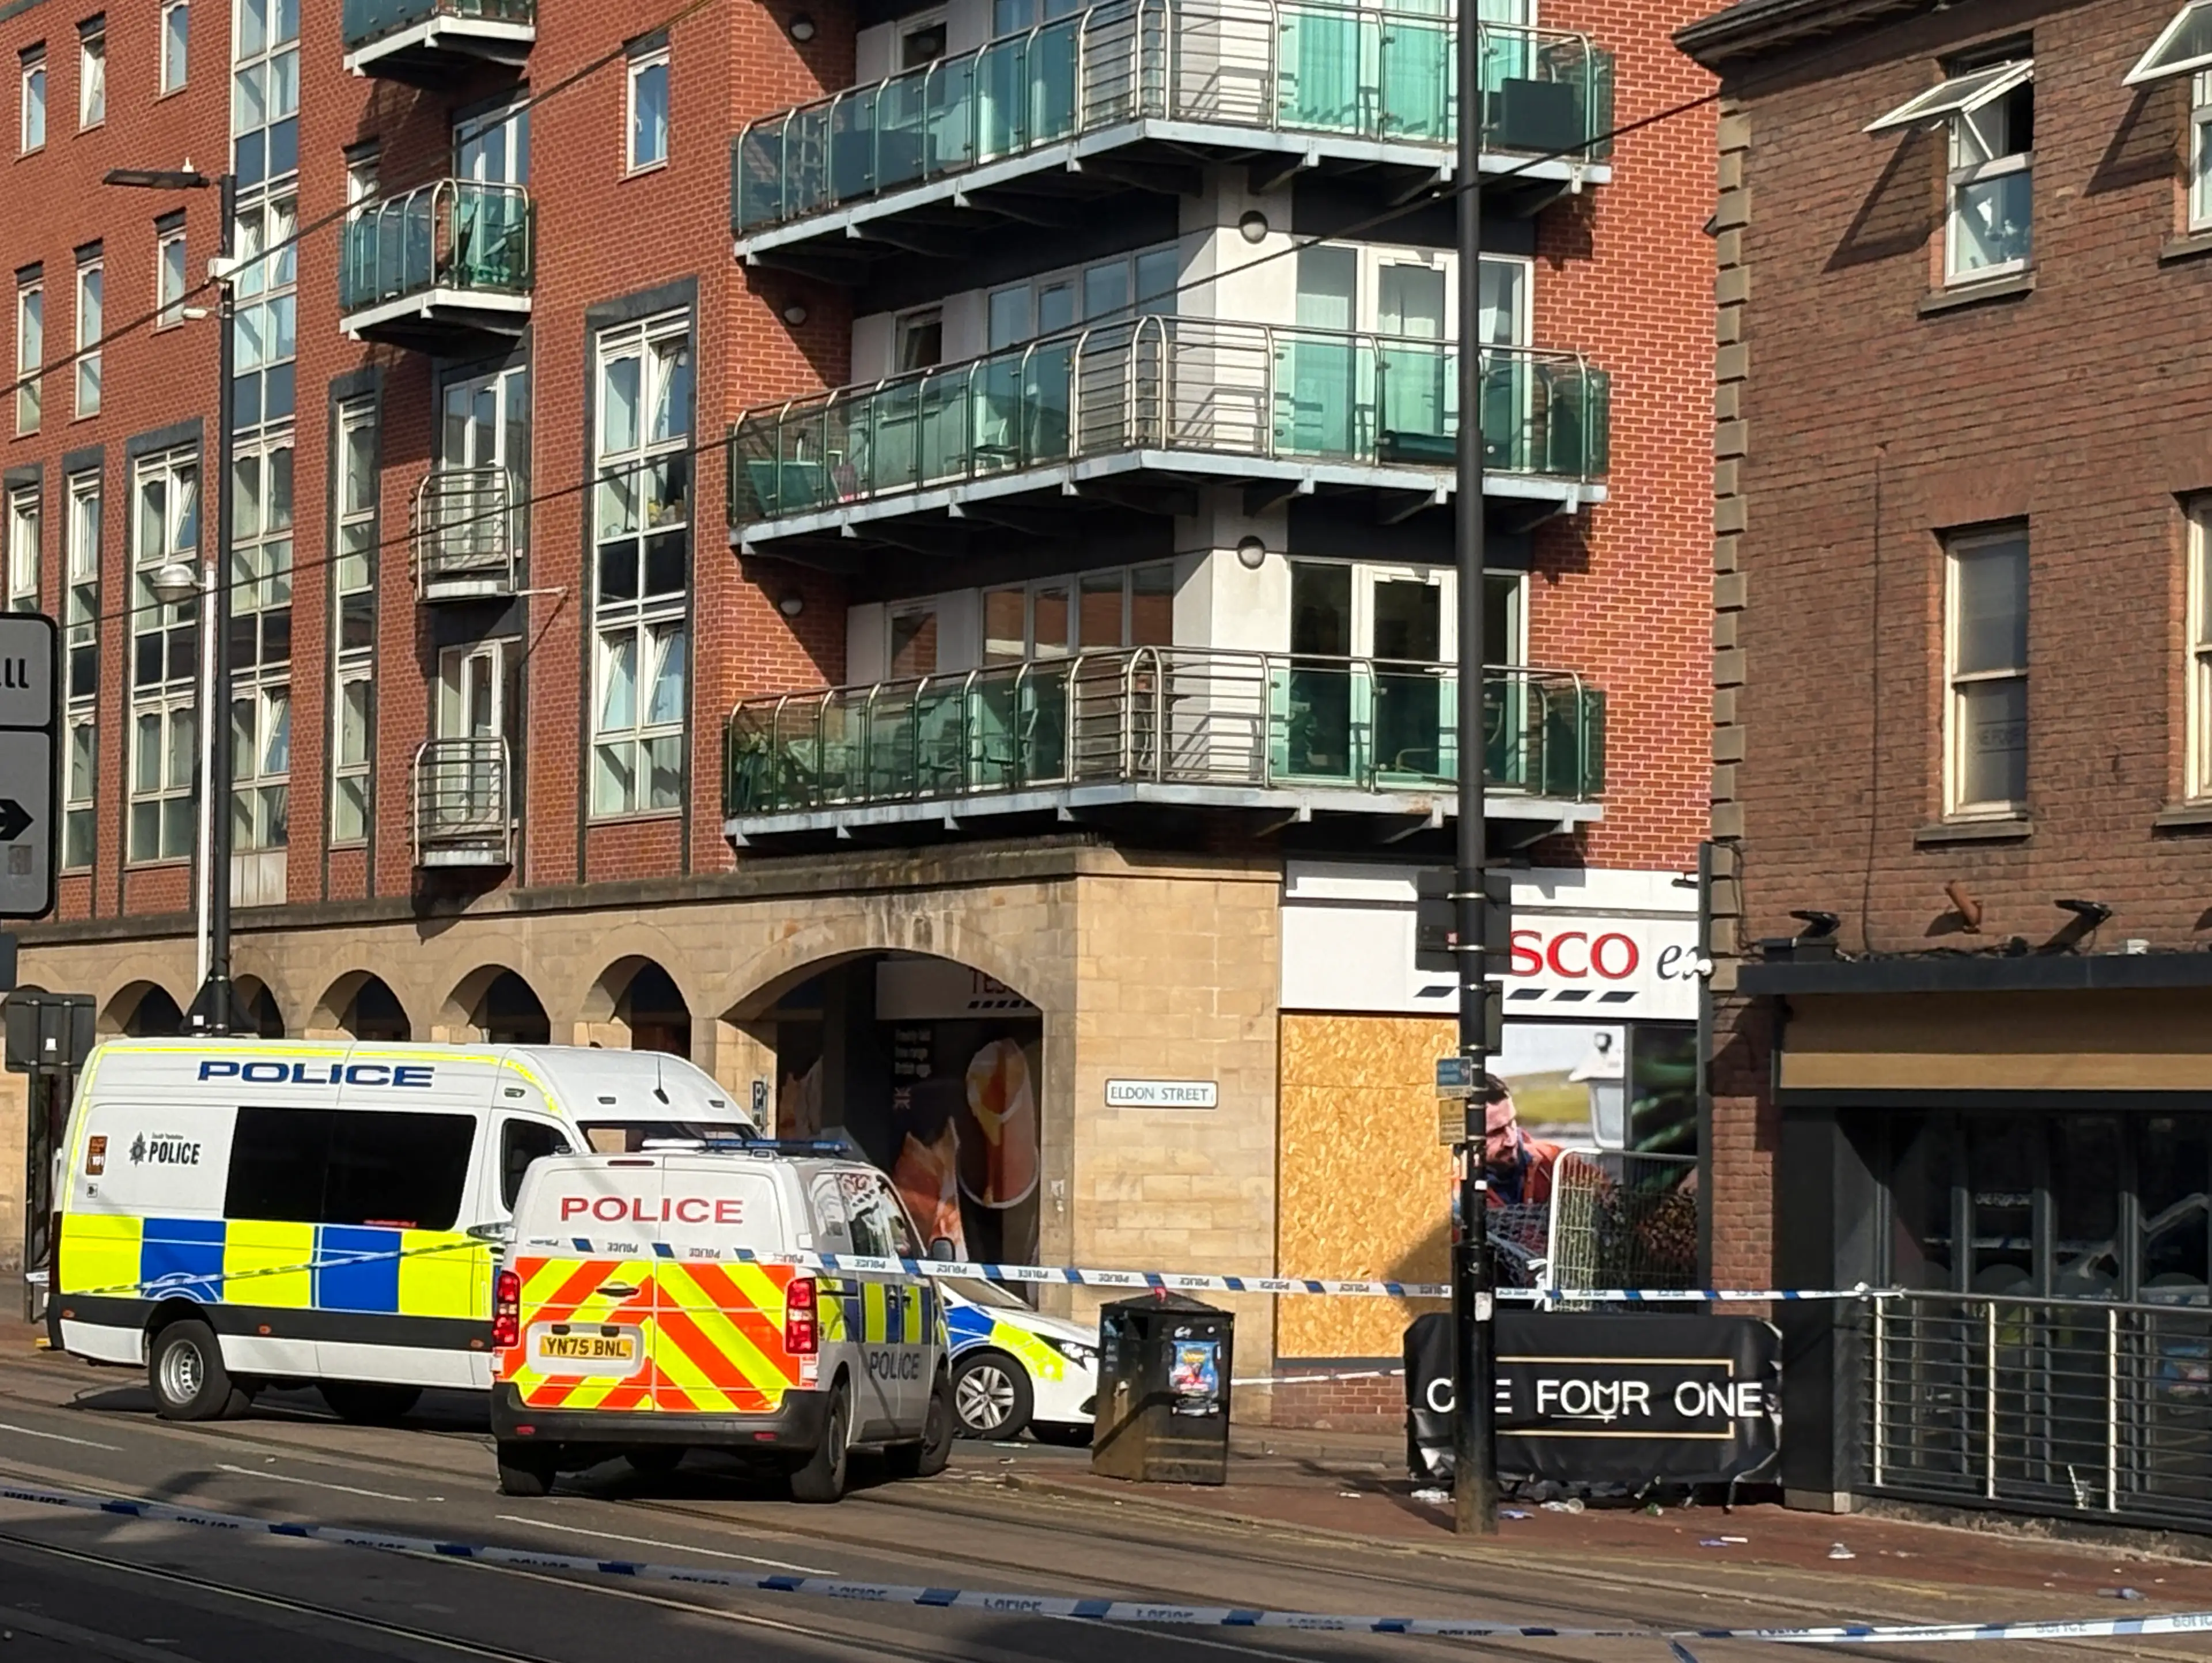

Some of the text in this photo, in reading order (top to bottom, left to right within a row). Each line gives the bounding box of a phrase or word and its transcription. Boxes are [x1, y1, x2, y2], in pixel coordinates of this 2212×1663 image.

[0, 658, 29, 688] ll
[198, 1061, 435, 1087] POLICE
[1111, 1086, 1209, 1101] ELDON STREET
[149, 1142, 200, 1165] POLICE
[560, 1197, 744, 1223] POLICE
[547, 1338, 627, 1357] YN75 BNL
[869, 1351, 921, 1381] POLICE
[1427, 1378, 1512, 1414] OE
[1675, 1381, 1763, 1417] ONE
